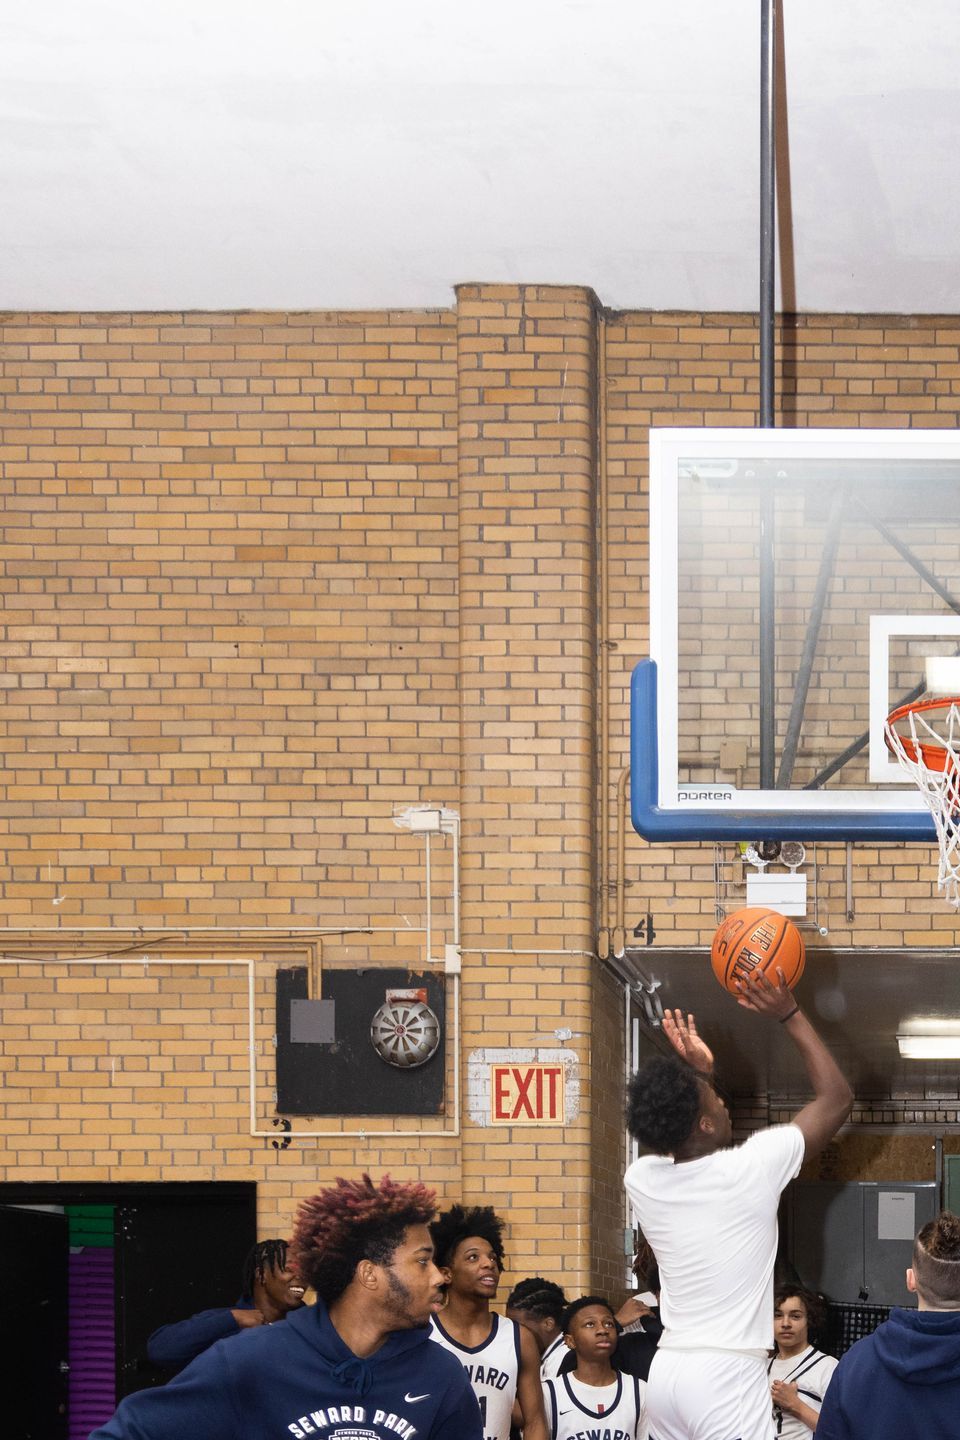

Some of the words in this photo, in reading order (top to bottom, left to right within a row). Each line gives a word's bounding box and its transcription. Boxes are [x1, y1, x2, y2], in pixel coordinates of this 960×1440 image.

[633, 912, 657, 946] 4
[750, 921, 778, 952] THE
[495, 1068, 561, 1120] EXIT
[272, 1118, 292, 1150] 3
[463, 1365, 510, 1391] WARD
[288, 1405, 366, 1440] SEWARD
